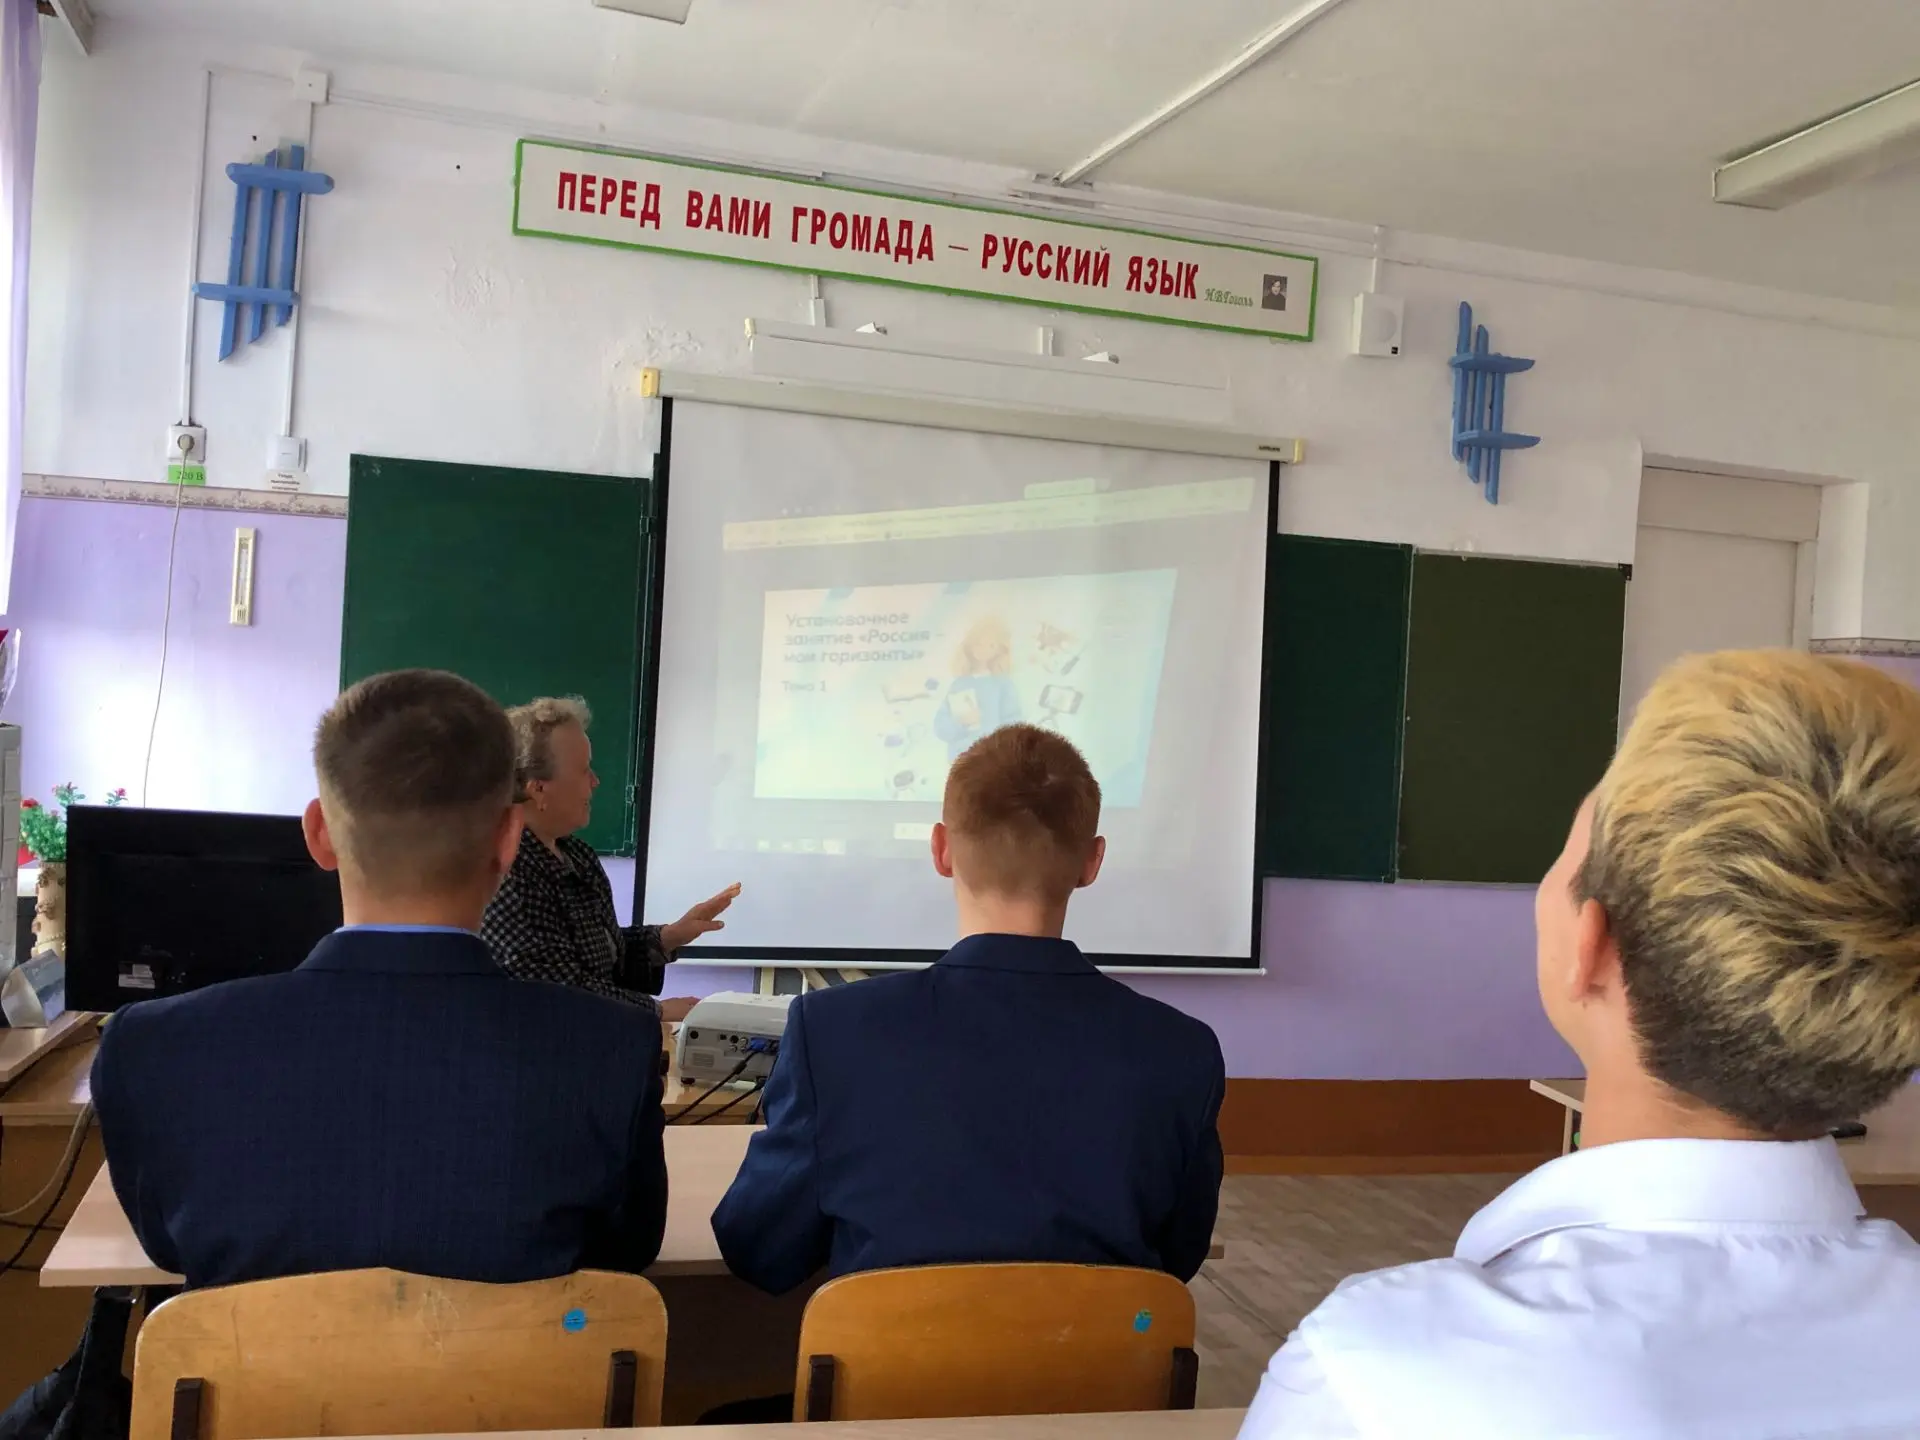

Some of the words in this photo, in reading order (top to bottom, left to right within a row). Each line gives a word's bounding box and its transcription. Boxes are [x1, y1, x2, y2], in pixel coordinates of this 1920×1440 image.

[557, 171, 662, 232] ПЕРЕД
[685, 190, 772, 239] ВАМИ
[791, 206, 935, 266] ГРОМАДА
[981, 232, 1111, 289] РУССКИЙ
[1125, 255, 1200, 300] ЯЗЫК
[196, 471, 204, 481] В
[785, 612, 909, 628] Установочное
[783, 633, 854, 646] занятие
[859, 629, 931, 644] «Россия
[784, 651, 817, 663] мои
[821, 649, 925, 666] горизонты»
[781, 680, 815, 692] Тема
[819, 680, 827, 692] 1
